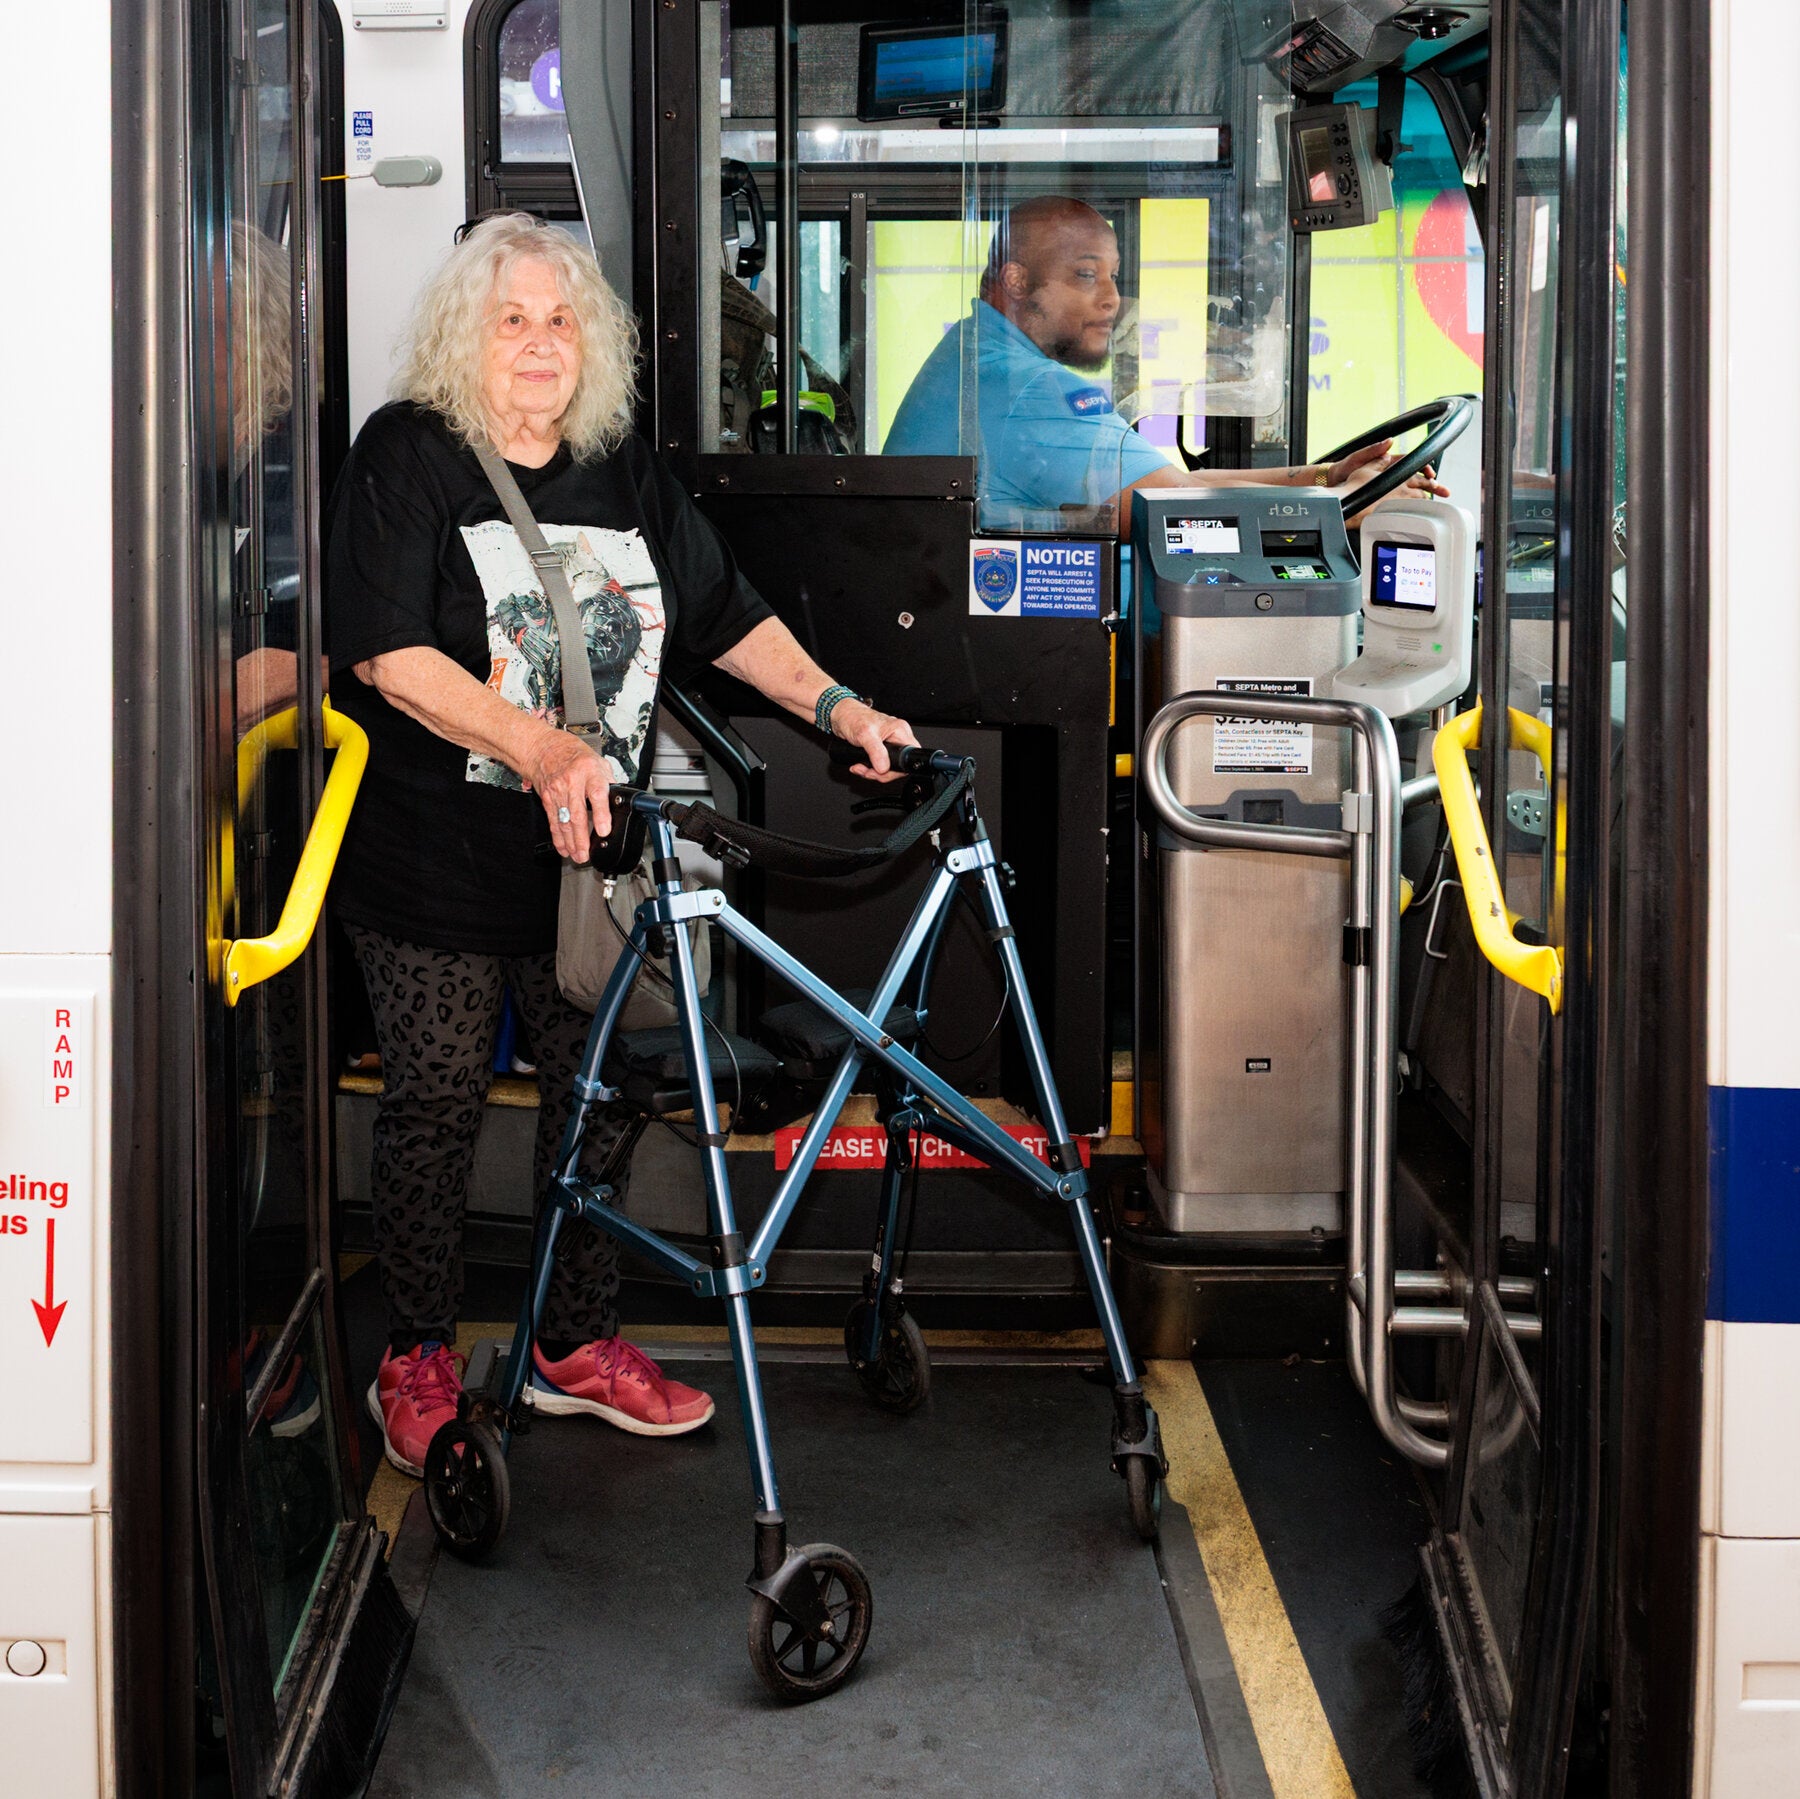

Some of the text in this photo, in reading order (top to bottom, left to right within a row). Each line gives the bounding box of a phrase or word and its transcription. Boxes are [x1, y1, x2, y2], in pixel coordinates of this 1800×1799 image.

[1190, 520, 1224, 528] SEPTA
[1026, 548, 1095, 566] NOTICE
[1402, 566, 1412, 574] Tap
[1421, 568, 1432, 577] Pay
[1235, 683, 1259, 691] SEPTA
[53, 1009, 73, 1104] RAMP
[791, 1138, 874, 1158] PEASE
[877, 1137, 952, 1157] TCH
